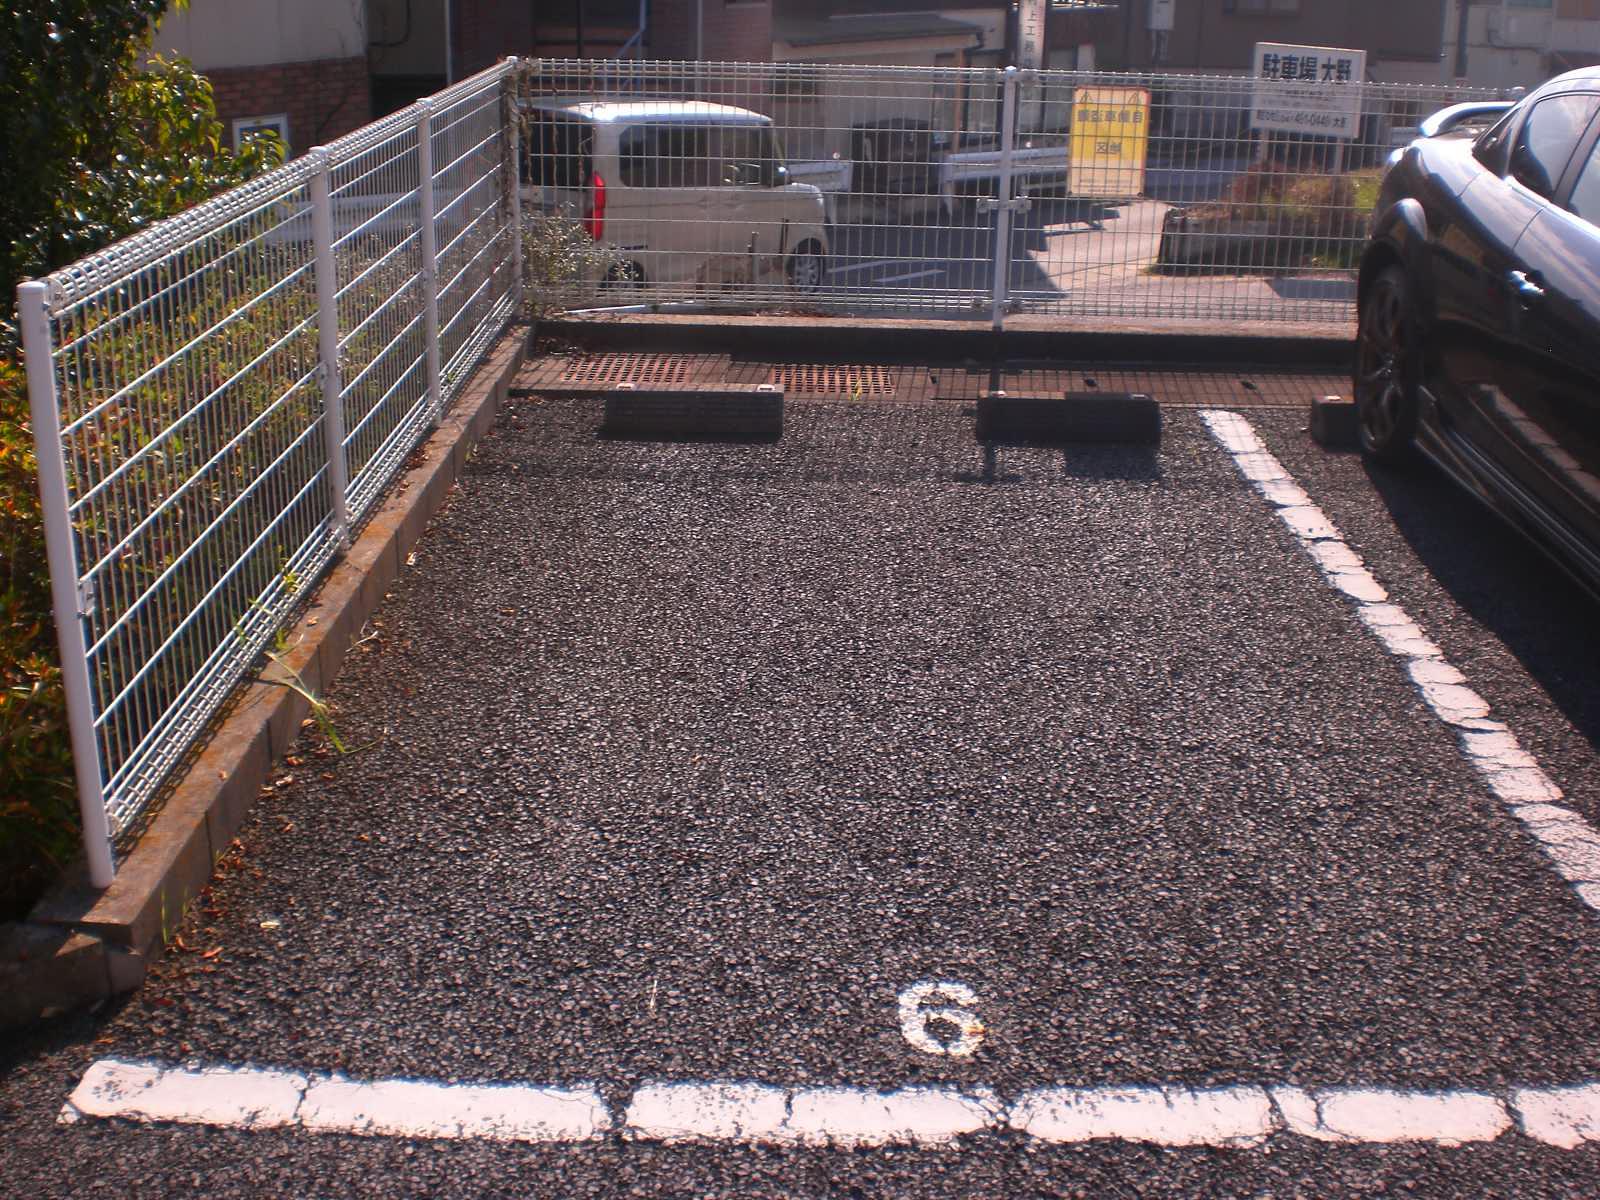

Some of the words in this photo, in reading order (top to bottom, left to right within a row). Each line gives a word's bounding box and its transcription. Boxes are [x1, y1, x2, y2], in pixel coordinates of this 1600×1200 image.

[1262, 53, 1318, 80] 駐車場
[1321, 56, 1353, 81] 大野
[898, 982, 984, 1056] 6
